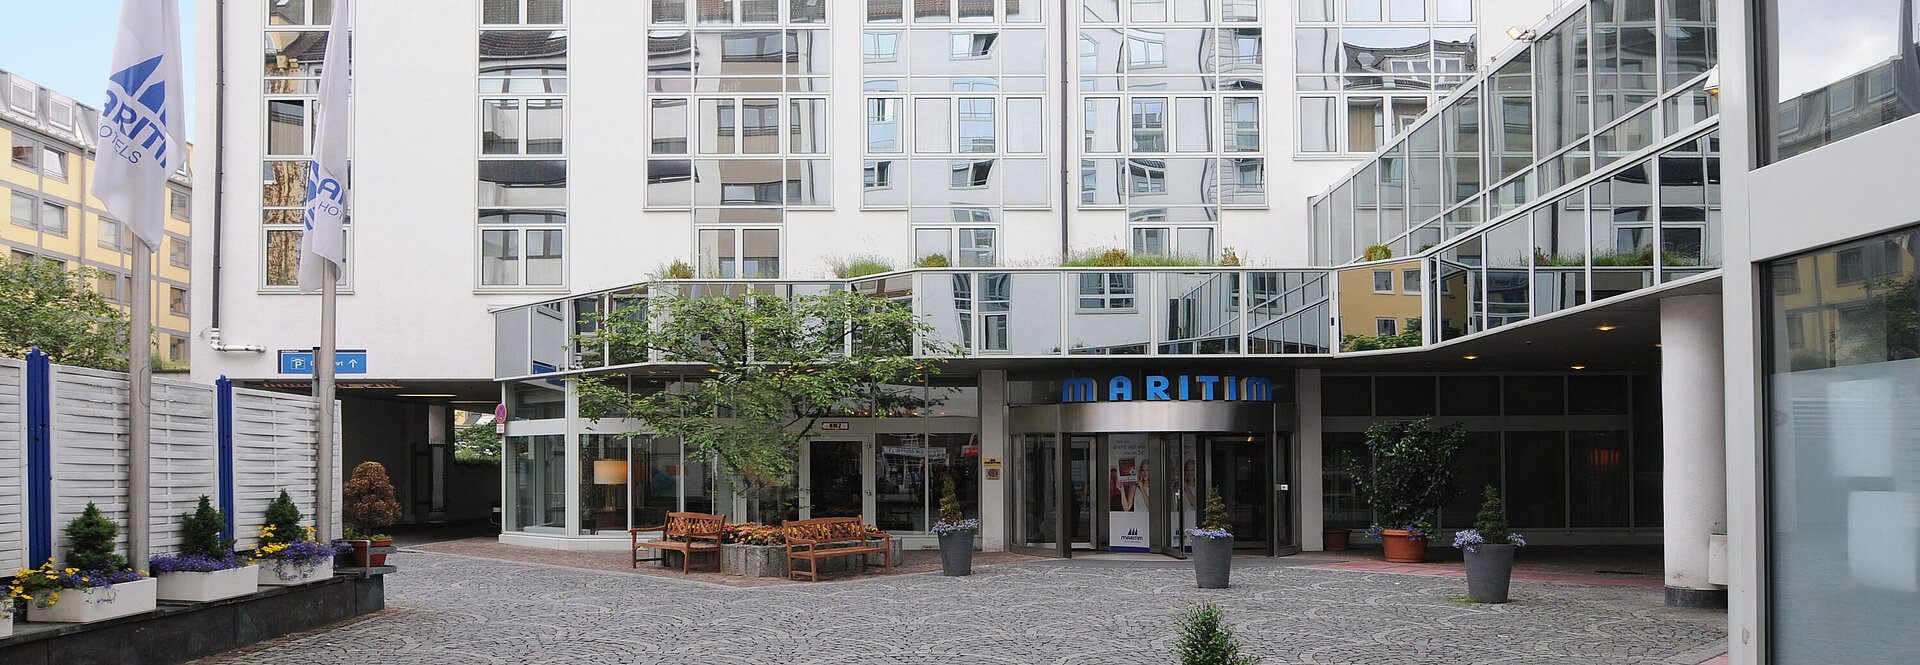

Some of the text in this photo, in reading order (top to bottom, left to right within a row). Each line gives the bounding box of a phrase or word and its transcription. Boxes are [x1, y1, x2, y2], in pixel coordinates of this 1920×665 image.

[99, 125, 142, 164] OTELS
[102, 89, 166, 169] ARITI
[318, 201, 344, 220] HOT
[1062, 375, 1273, 402] MARITIM
